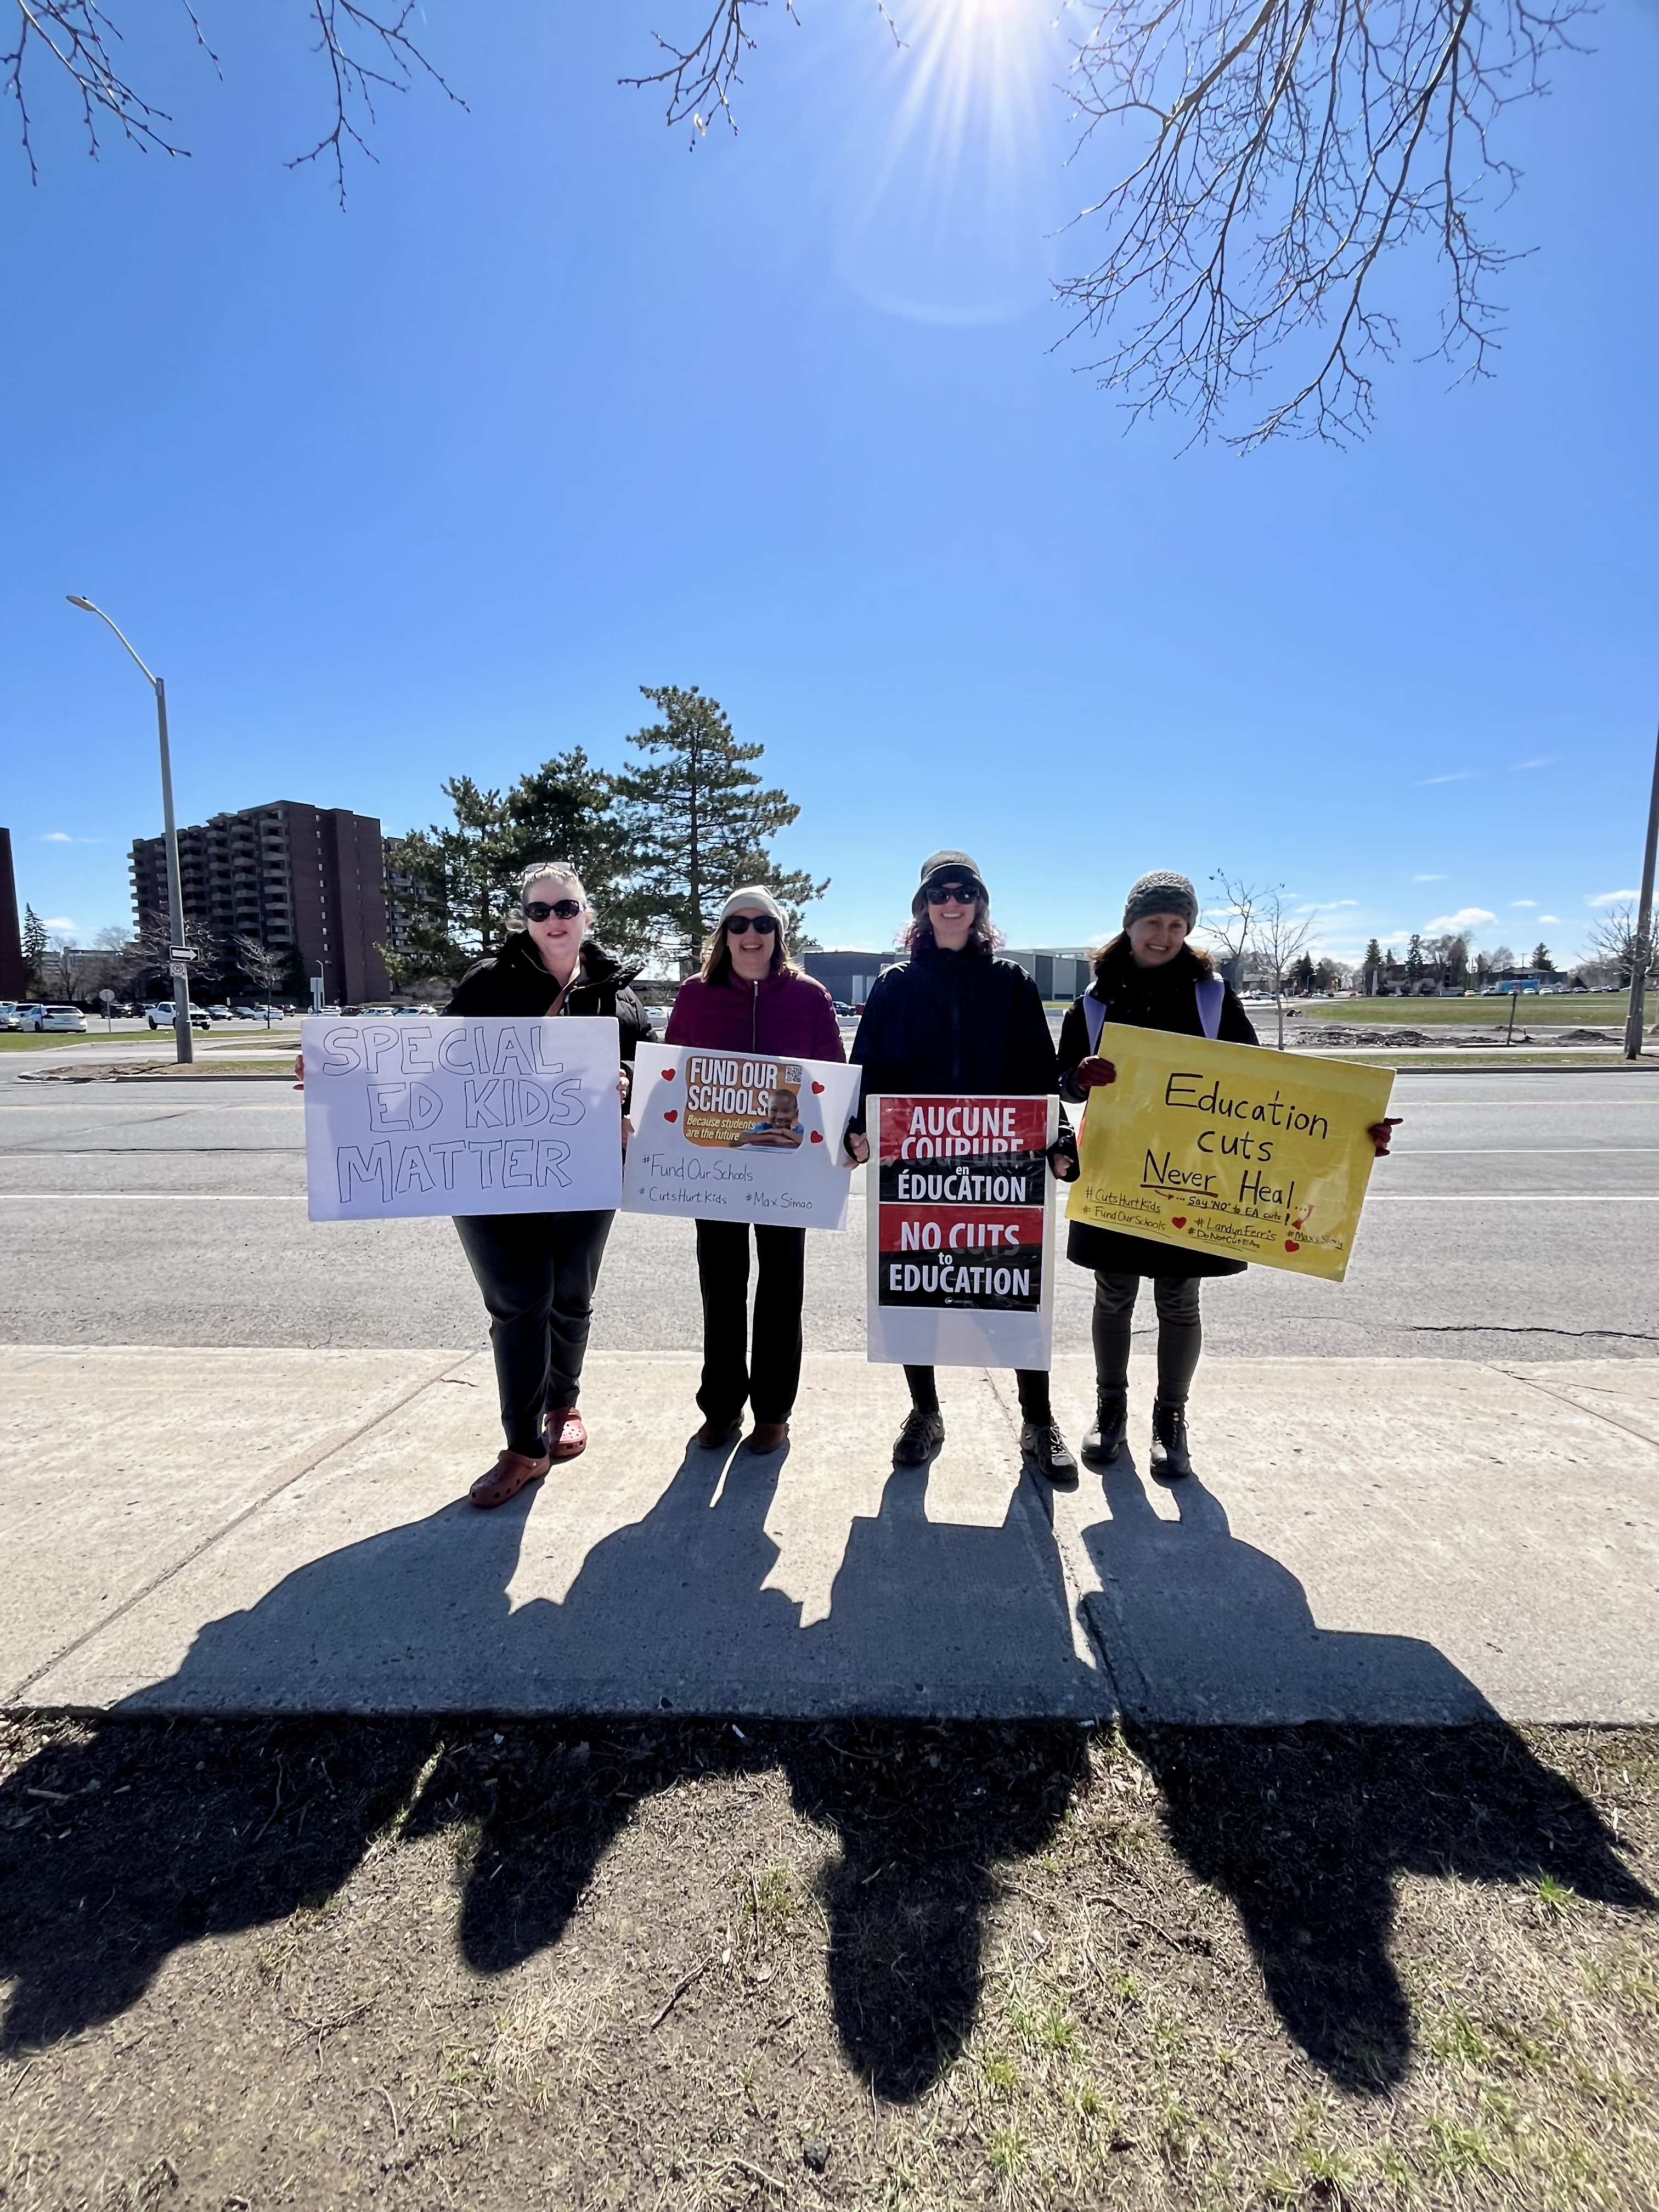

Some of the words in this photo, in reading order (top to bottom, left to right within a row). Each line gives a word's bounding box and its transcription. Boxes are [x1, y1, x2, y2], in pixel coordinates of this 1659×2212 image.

[323, 1025, 563, 1076] SPECIAL
[690, 1058, 738, 1086] FUND
[742, 1062, 778, 1090] OUR
[366, 1081, 443, 1132] ED
[465, 1079, 586, 1128] KIDS
[688, 1085, 769, 1116] SCHOOLS
[1165, 1073, 1328, 1139] Education
[685, 1129, 699, 1138] are
[700, 1128, 714, 1139] the
[714, 1130, 740, 1141] future
[687, 1114, 723, 1127] Because
[721, 1118, 756, 1130] students
[910, 1106, 1016, 1137] AUCUNE
[901, 1137, 1024, 1167] COUPURE
[1197, 1130, 1273, 1161] cuts
[336, 1139, 573, 1203] MATTER
[898, 1169, 1026, 1201] ÉDUCATION
[956, 1166, 969, 1175] en
[1143, 1149, 1217, 1190] Never
[1189, 1196, 1207, 1208] Say
[1233, 1204, 1240, 1214] to
[1245, 1207, 1258, 1217] EA
[901, 1221, 941, 1253] NO
[949, 1223, 1020, 1256] CUTS
[938, 1252, 952, 1265] to
[889, 1265, 1030, 1296] EDUCATION
